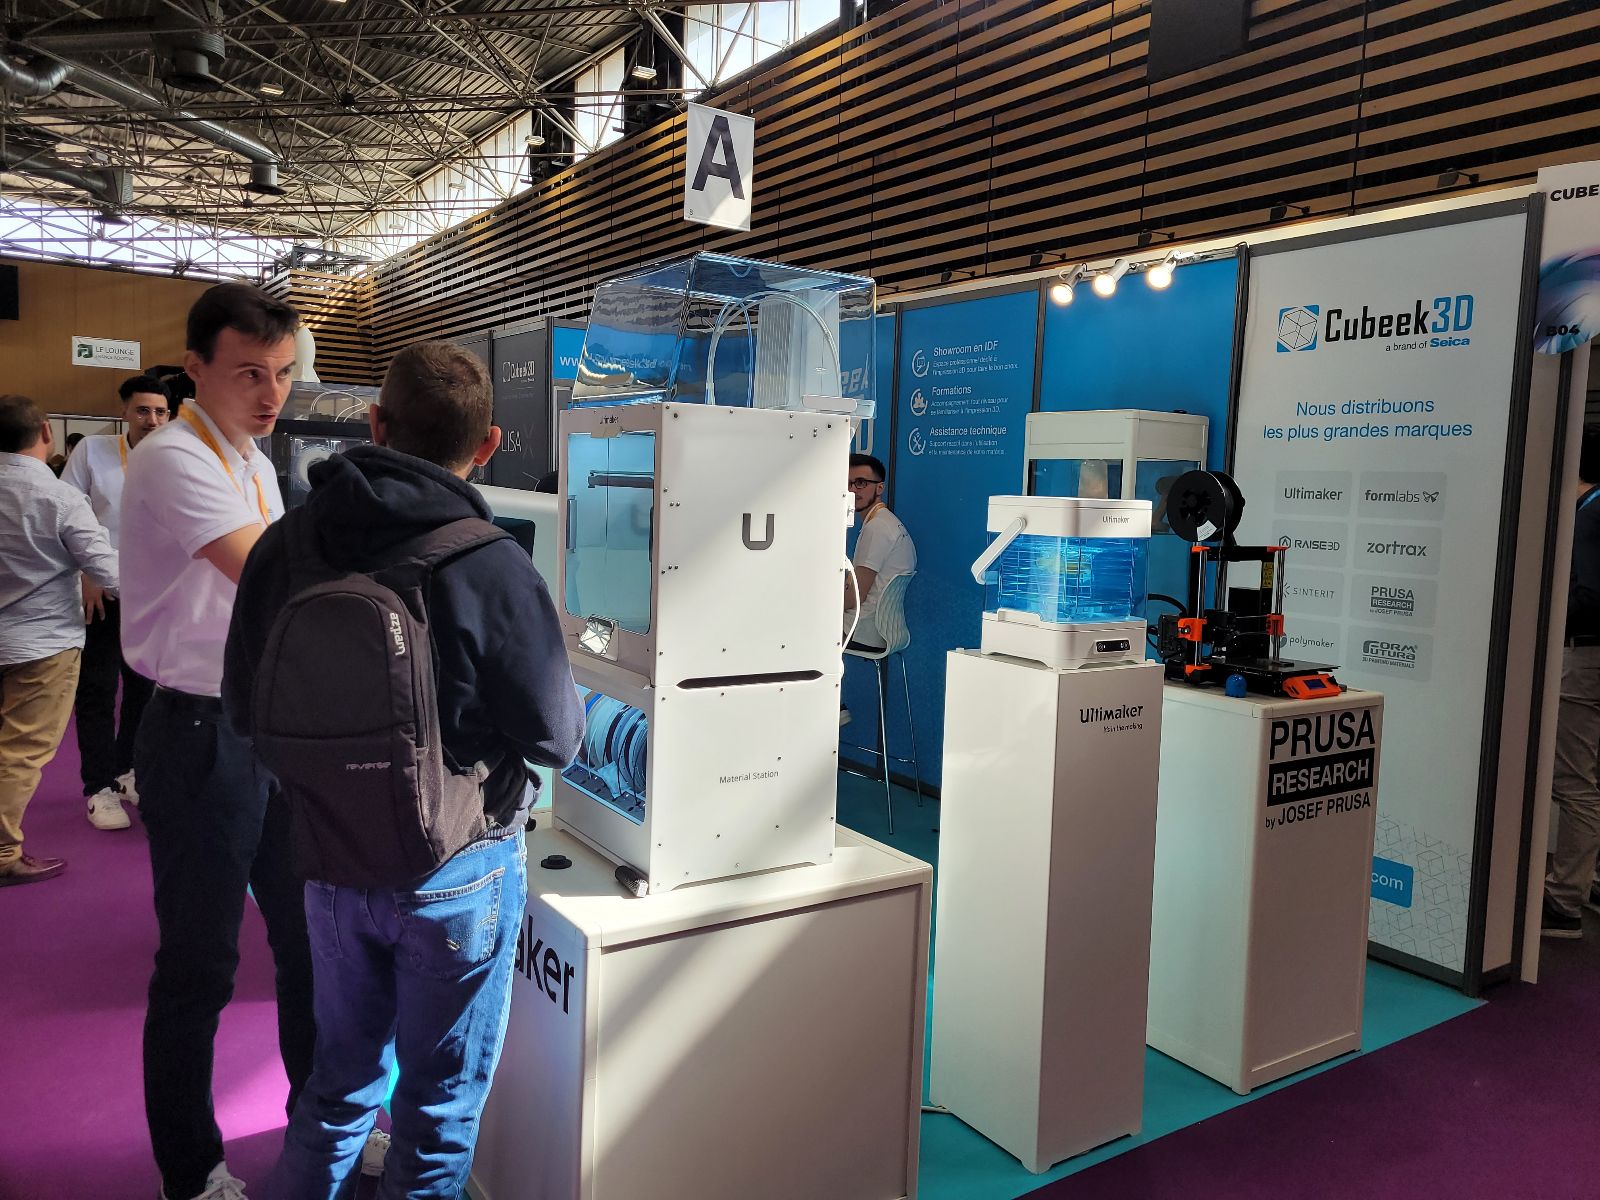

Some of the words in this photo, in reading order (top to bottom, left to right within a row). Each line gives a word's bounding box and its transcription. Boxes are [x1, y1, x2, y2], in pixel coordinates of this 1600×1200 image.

[692, 115, 745, 200] A
[1550, 184, 1600, 202] CUBE
[105, 347, 135, 355] LOUNGE
[933, 345, 972, 356] Showroom
[974, 344, 983, 352] en
[985, 340, 998, 350] IDF
[1393, 341, 1417, 351] brand
[1418, 341, 1427, 349] of
[1430, 336, 1470, 348] Seica
[932, 386, 972, 396] Formations
[1296, 401, 1336, 417] Nous
[1341, 398, 1435, 415] distribuons
[930, 426, 968, 436] Assistance
[970, 425, 1007, 436] technique
[1263, 424, 1283, 439] les
[1287, 424, 1319, 442] plus
[1323, 422, 1389, 442] grandes
[1394, 422, 1473, 440] marques
[502, 430, 522, 452] LISA
[1284, 487, 1343, 500] Ultimaker
[1365, 490, 1420, 502] formlabs
[742, 513, 775, 551] U
[1294, 539, 1340, 550] RAISE3D
[1366, 540, 1428, 556] zortrax
[1371, 586, 1415, 600] PRUSA
[1372, 599, 1412, 610] RESEARCH
[1289, 636, 1334, 649] polymaker
[1080, 704, 1144, 724] Ultimaker
[1269, 709, 1376, 760] PRUSA
[719, 771, 750, 784] Material
[752, 769, 779, 782] Station
[1272, 758, 1370, 796] RESEARCH
[1265, 816, 1276, 830] by
[1278, 800, 1324, 826] JOSEF
[1326, 792, 1370, 816] PRUSA
